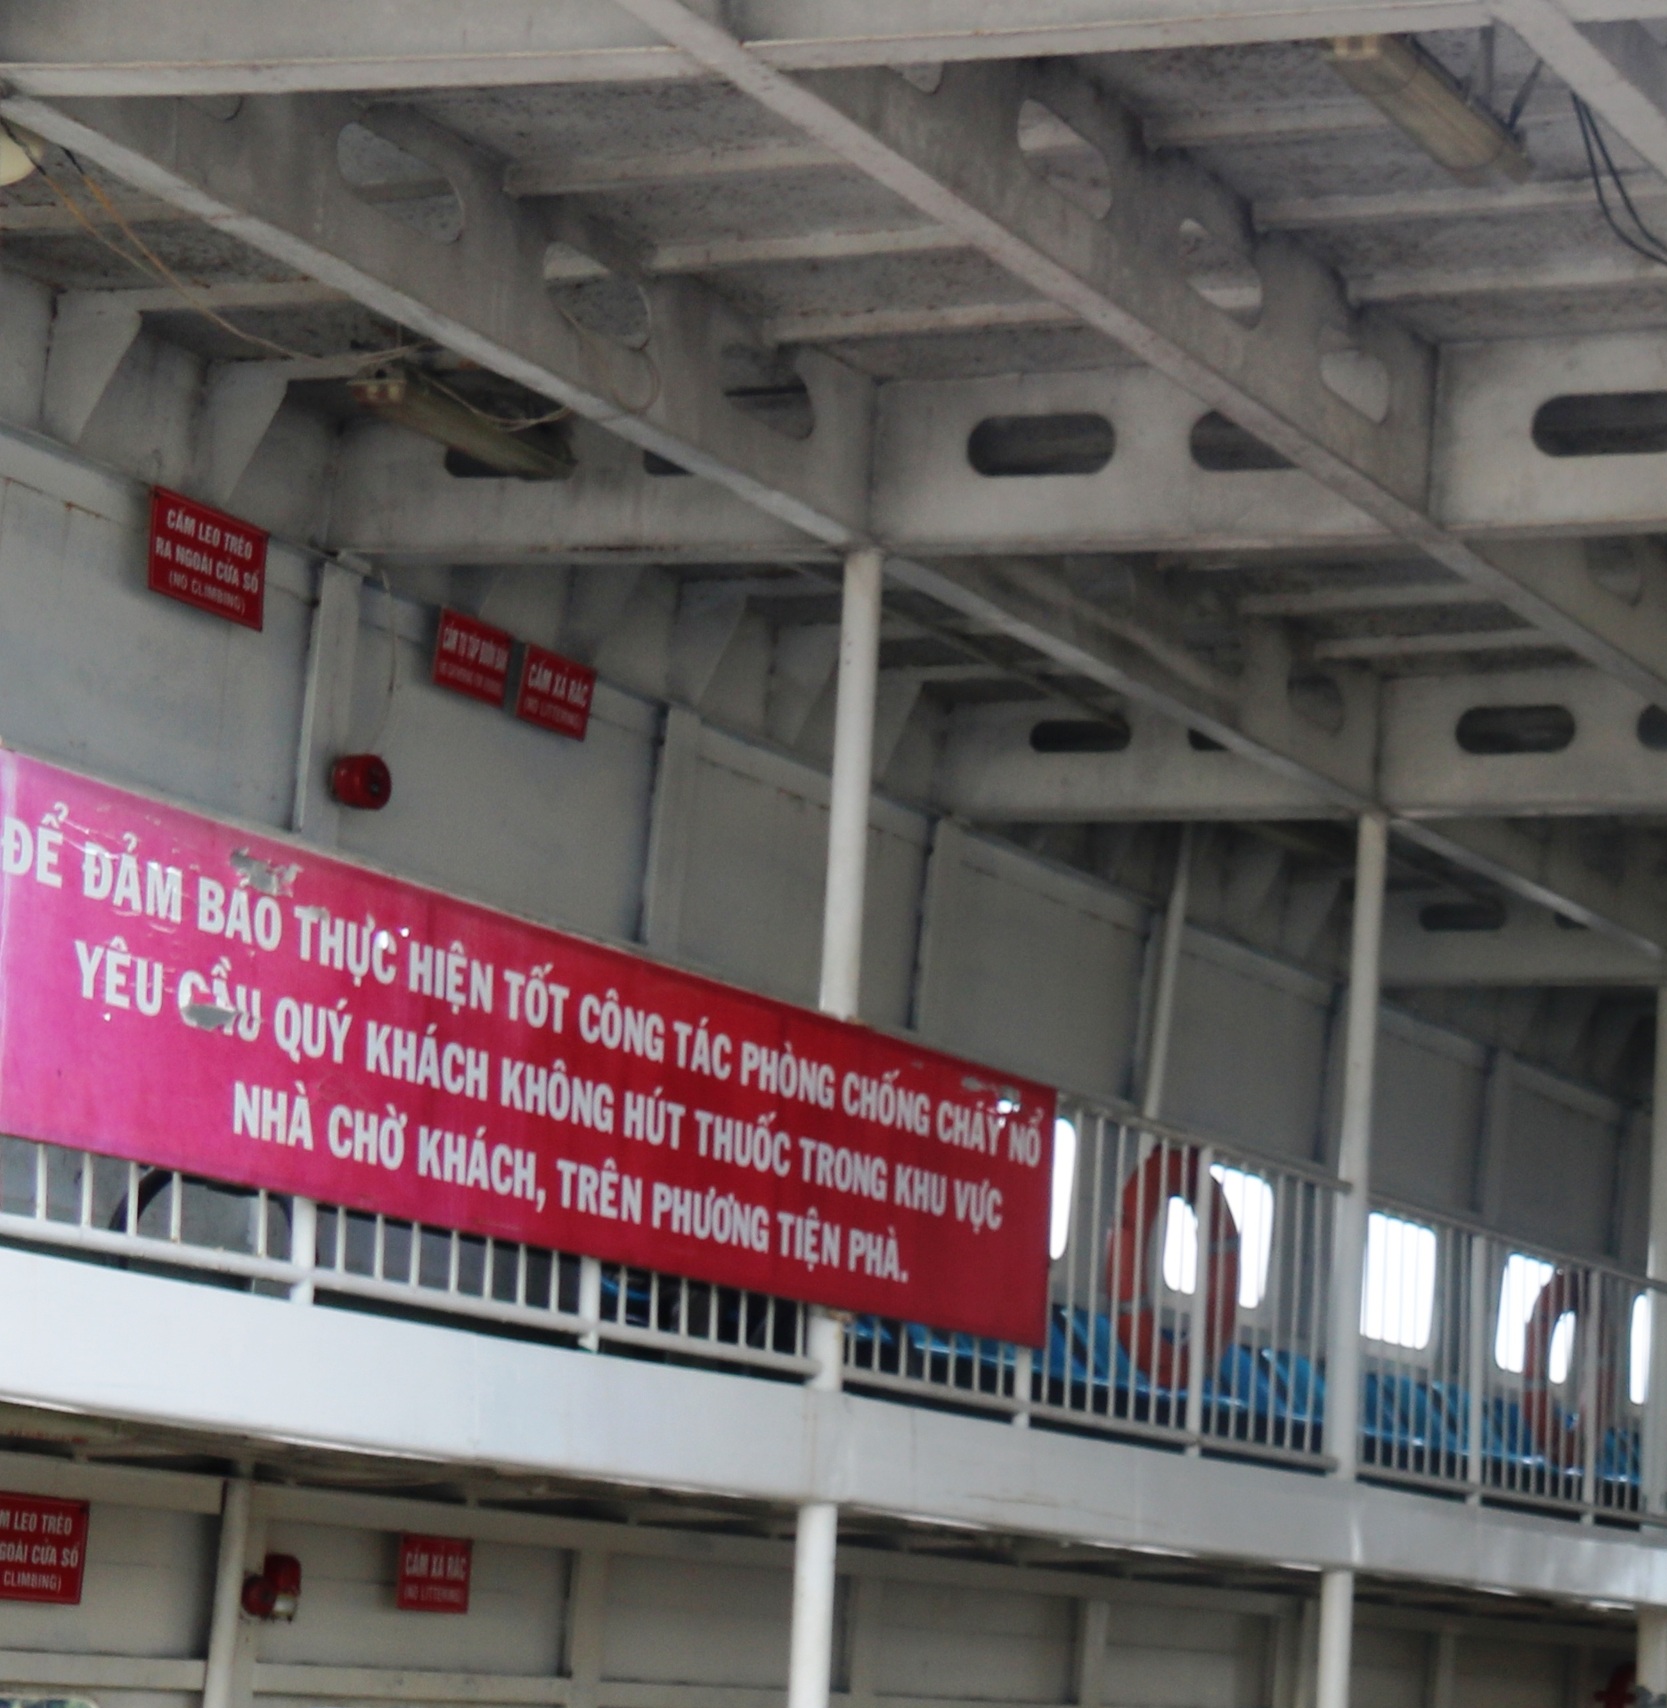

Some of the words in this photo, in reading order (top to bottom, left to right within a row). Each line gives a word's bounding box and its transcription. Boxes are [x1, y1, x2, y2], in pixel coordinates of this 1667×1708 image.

[198, 522, 220, 548] LEO
[155, 536, 172, 560] RA
[1, 802, 69, 888] ĐỂ
[82, 832, 183, 924] ĐẢM
[198, 876, 282, 951] BẢO
[294, 905, 397, 988] THỰC
[409, 940, 494, 1015] HIỆN
[504, 962, 570, 1034] TỐT
[579, 988, 665, 1064] CÔNG
[673, 1016, 732, 1081] TÁC
[740, 1040, 836, 1110] PHÒNG
[841, 1068, 930, 1137] CHỐNG
[936, 1099, 1007, 1157] CHÁY
[1008, 1107, 1045, 1168] NỔ
[75, 935, 164, 1016] YÊU
[274, 998, 353, 1064] QUÝ
[366, 1022, 490, 1102] KHÁCH
[501, 1059, 615, 1135] KHÔNG
[623, 1085, 686, 1150] HÚT
[694, 1111, 791, 1178] THUỐC
[799, 1137, 887, 1202] TRONG
[894, 1163, 948, 1217] KHU
[953, 1178, 1003, 1235] VỰC
[233, 1080, 314, 1151] NHÀ
[327, 1102, 408, 1171] CHỜ
[417, 1126, 546, 1213] KHÁCH,
[556, 1156, 643, 1225] TRÊN
[652, 1186, 770, 1253] PHƯƠNG
[776, 1206, 841, 1272] TIỆN
[848, 1226, 909, 1284] PHÀ.
[14, 1511, 37, 1532] LEO
[0, 1538, 28, 1563] GOÀI
[3, 1570, 62, 1593] CLIMBING)
